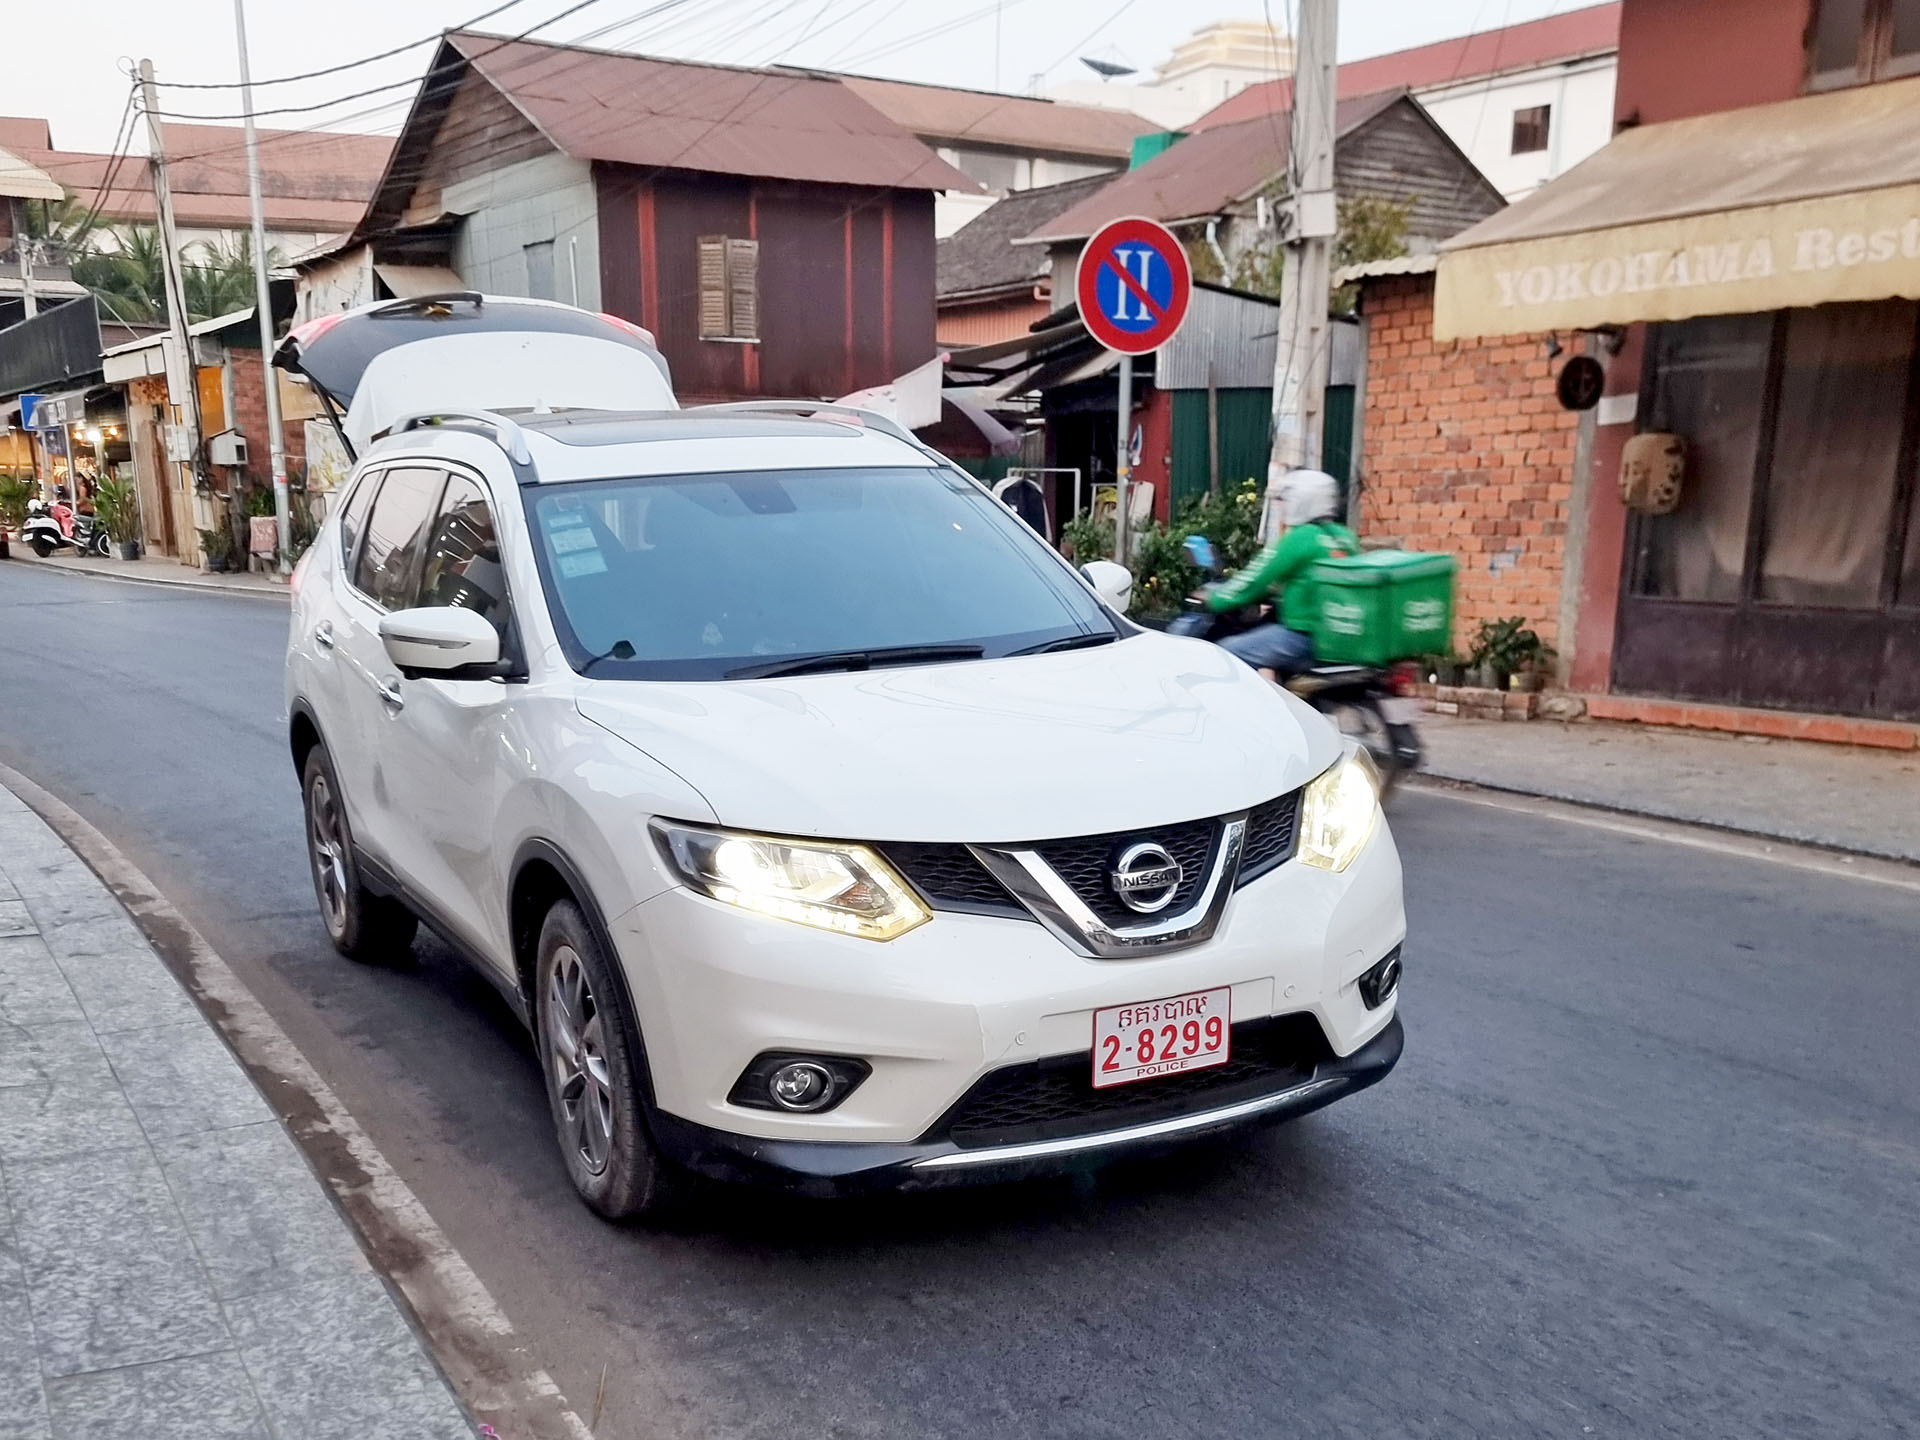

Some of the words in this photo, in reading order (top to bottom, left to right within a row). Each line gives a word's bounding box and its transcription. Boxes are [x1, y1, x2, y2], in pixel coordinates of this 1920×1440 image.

[1494, 239, 1775, 306] YOKOHAMA
[1123, 871, 1178, 887] NISSAN
[1101, 1016, 1222, 1071] 2-8299
[1136, 1060, 1189, 1077] POLICE
